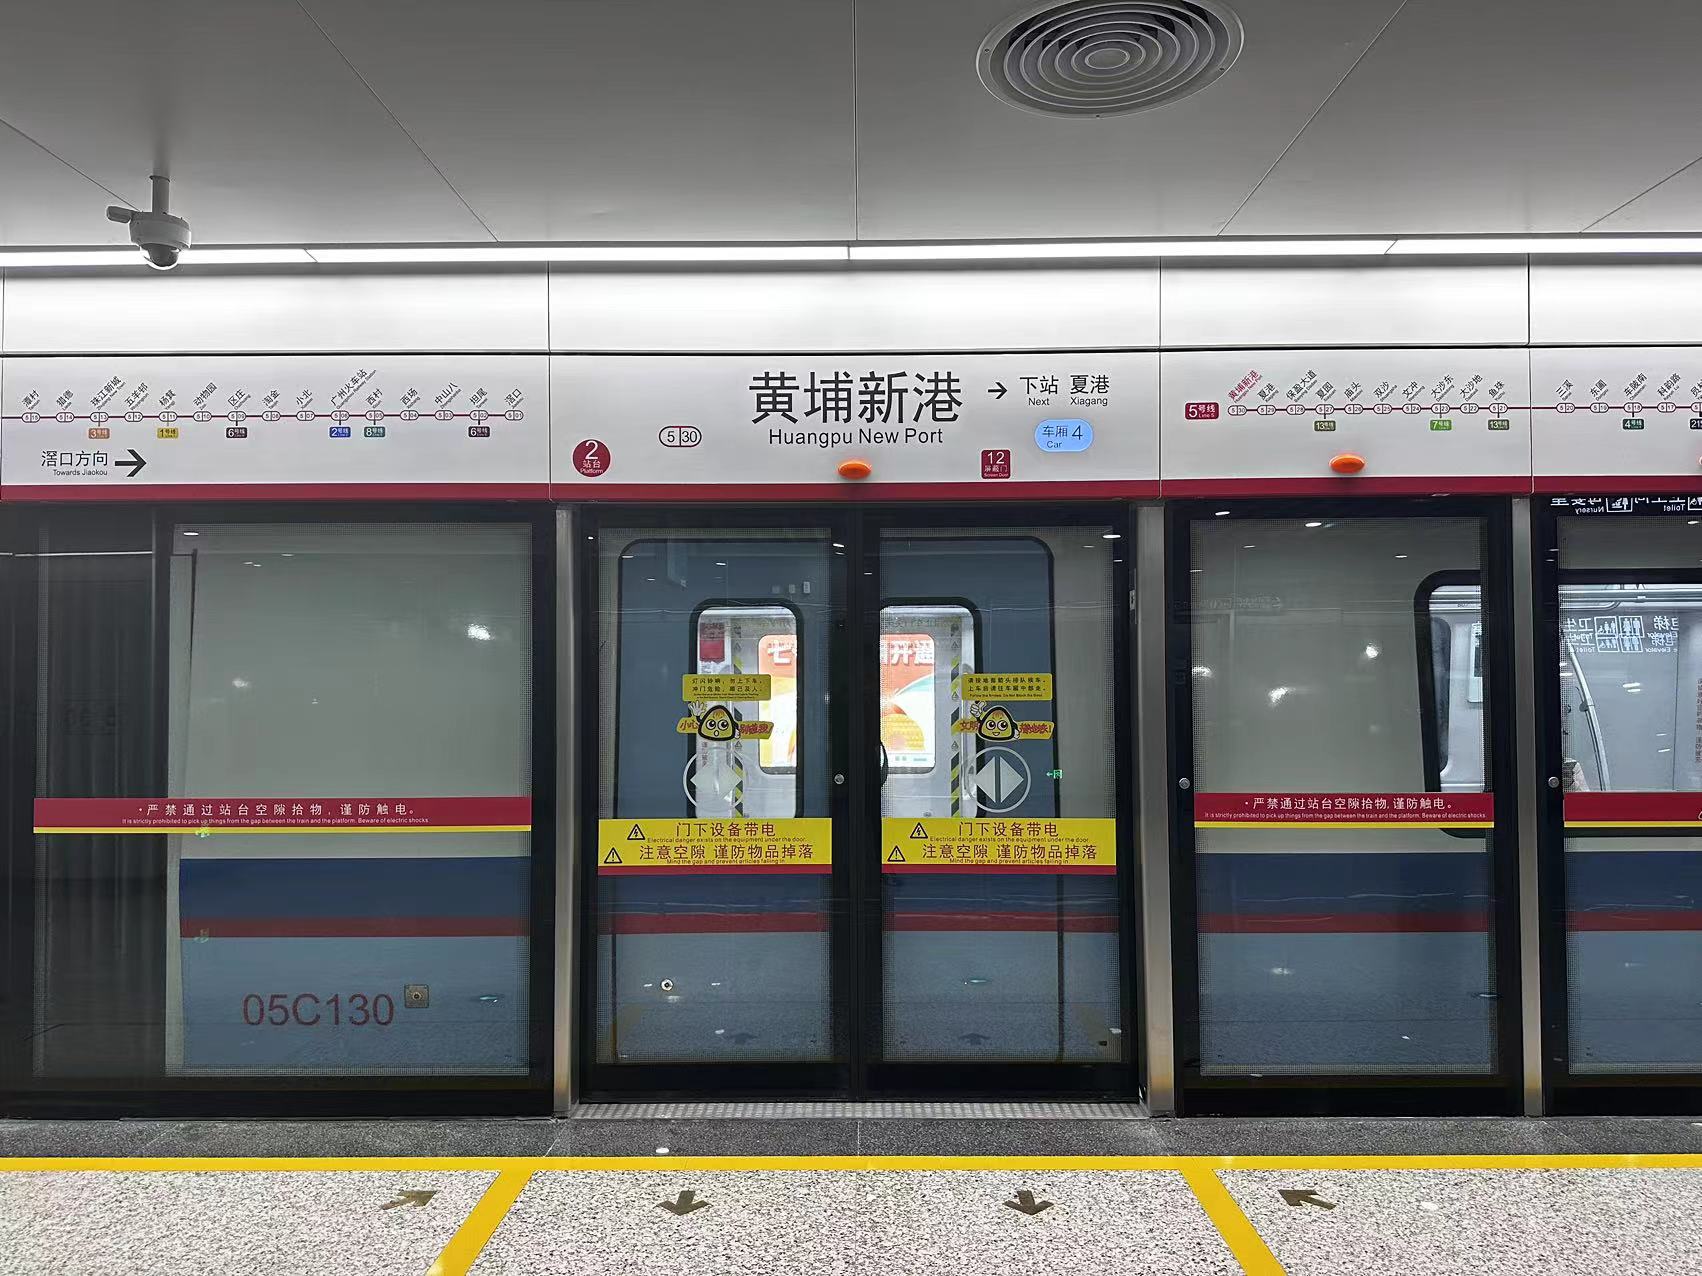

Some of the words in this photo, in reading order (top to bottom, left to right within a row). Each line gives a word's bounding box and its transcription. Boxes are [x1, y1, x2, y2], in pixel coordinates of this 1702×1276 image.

[90, 375, 122, 407] 珠江新城
[330, 368, 367, 406] 广州火车站
[434, 382, 458, 405] 中山八
[1020, 375, 1059, 395] 下站
[1069, 374, 1110, 394] 夏港
[1286, 369, 1318, 401] 保盈大道
[1315, 381, 1334, 400] 夏园
[1344, 381, 1361, 399] 庙头
[1373, 381, 1390, 399] 双沙
[1402, 381, 1418, 399] 文冲
[1430, 374, 1454, 398] 大沙东
[1459, 374, 1483, 398] 大沙地
[1488, 380, 1505, 399] 鱼珠
[193, 382, 218, 407] 动物园
[227, 388, 246, 407] 区庄
[296, 388, 313, 406] 小北
[366, 388, 383, 406] 西村
[400, 387, 418, 406] 西场
[749, 371, 963, 424] 黄埔新港
[1028, 397, 1050, 406] Next
[1070, 396, 1108, 407] Xiagang
[667, 431, 675, 443] 5
[682, 431, 698, 443] 30
[769, 428, 853, 449] Huangpu
[859, 428, 899, 444] New
[905, 428, 943, 444] Port
[1042, 425, 1068, 438] 车厢
[1071, 425, 1083, 440] 4
[41, 450, 108, 467] 滘口方向
[585, 440, 599, 460] 2
[987, 451, 1005, 464] 12
[582, 460, 601, 468] 站台
[676, 821, 776, 836] 门下设备带电
[959, 821, 1059, 836] 门下设备带电
[958, 836, 978, 844] danger
[639, 844, 706, 860] 注意空隙
[714, 844, 814, 860] 谨防物品掉落
[922, 843, 988, 860] 注意空隙
[996, 844, 1097, 860] 谨防物品掉落
[243, 993, 394, 1026] 05C130
